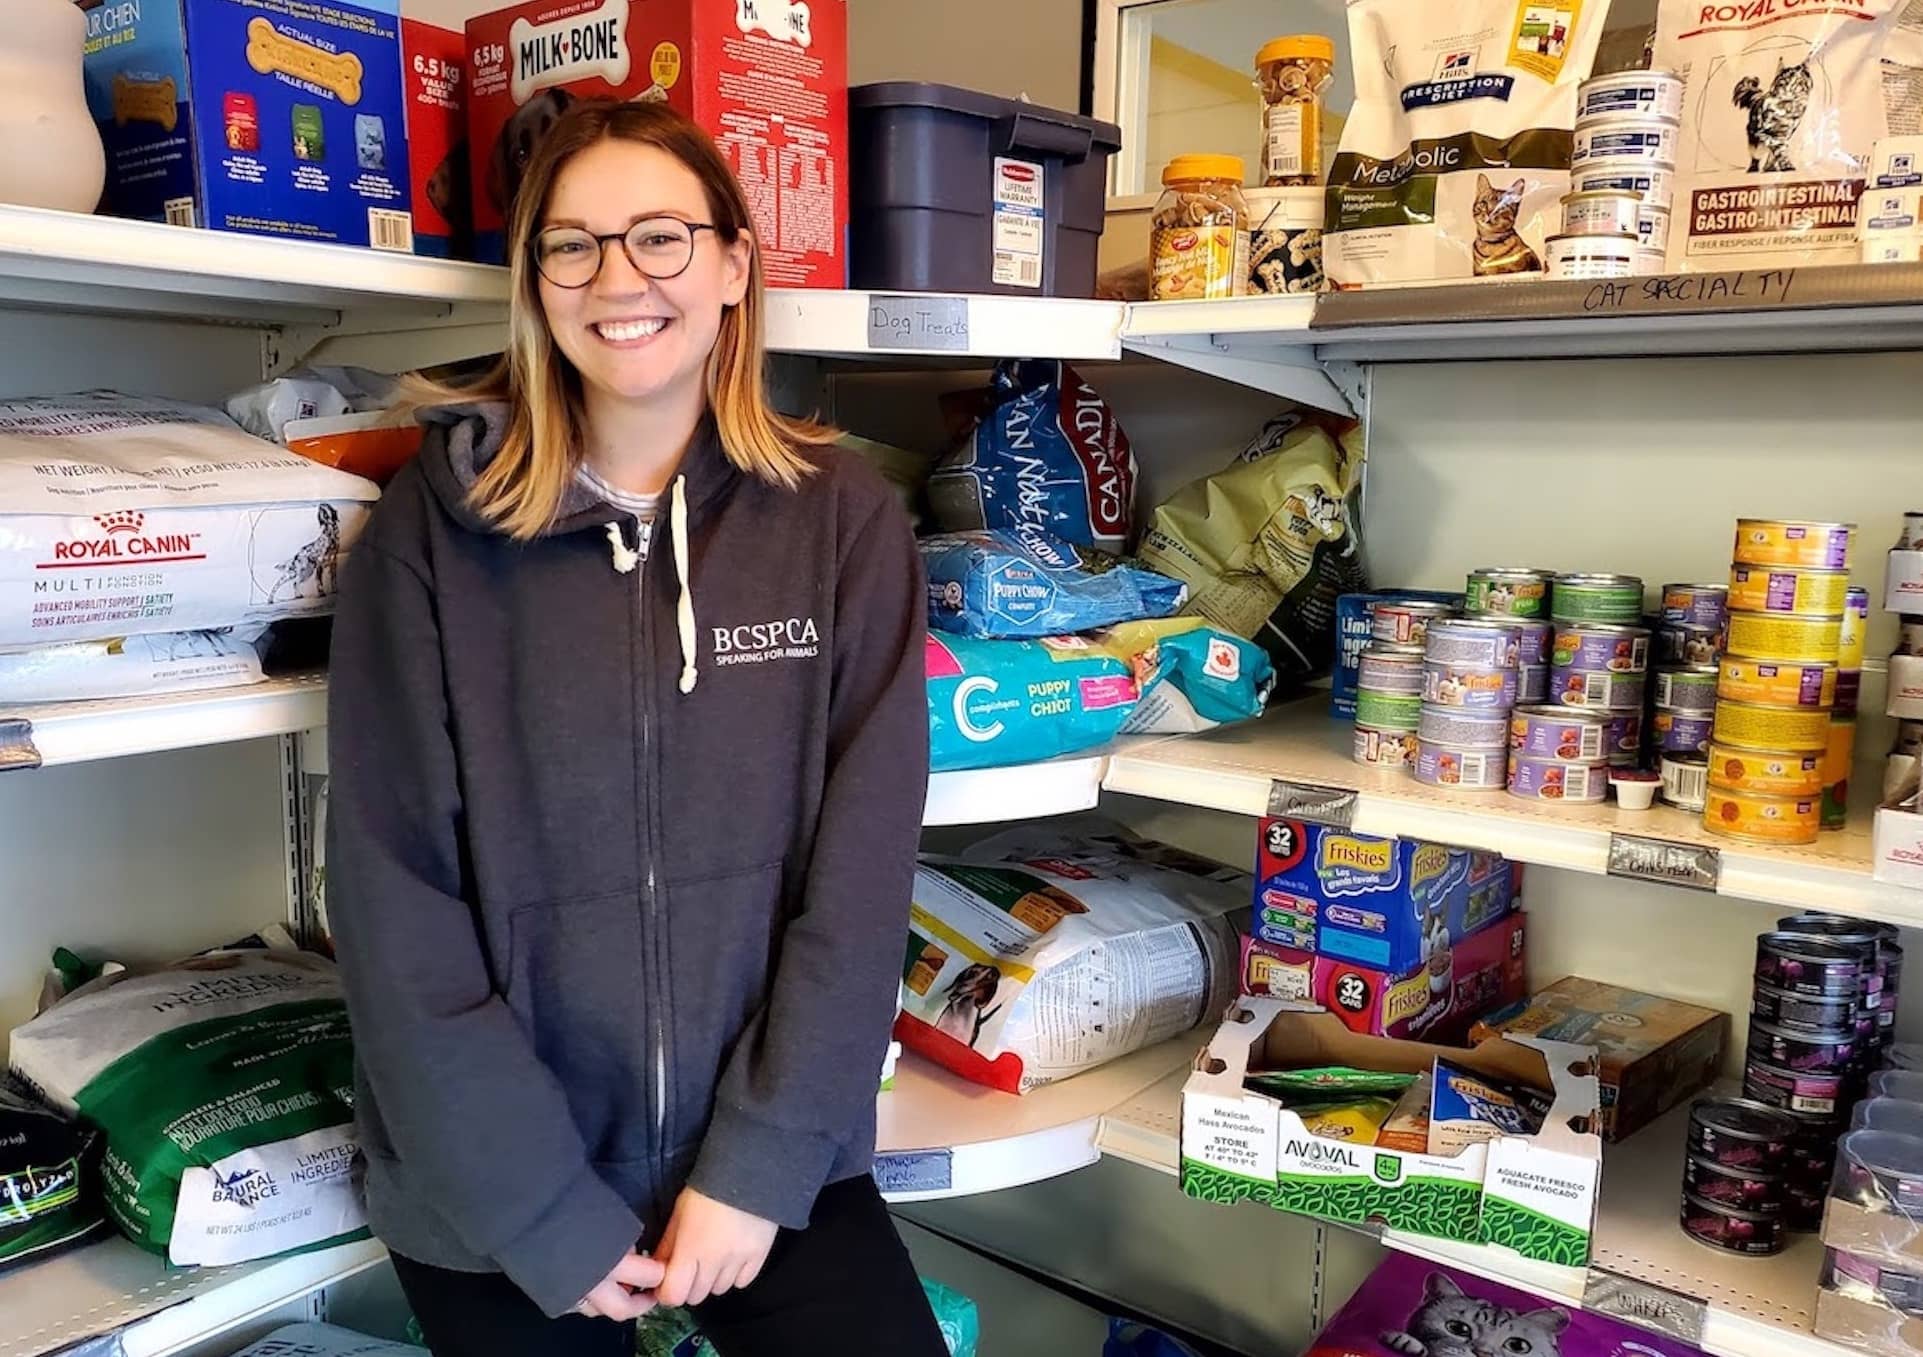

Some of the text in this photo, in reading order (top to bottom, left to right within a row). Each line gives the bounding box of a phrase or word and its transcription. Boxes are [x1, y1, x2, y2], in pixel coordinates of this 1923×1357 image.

[103, 0, 141, 31] CHIEN
[1700, 0, 1775, 24] ROYAL
[277, 24, 336, 53] ACTUAL SIZE
[521, 31, 564, 81] MILK
[571, 18, 618, 63] BONE
[490, 44, 505, 63] kg
[275, 71, 302, 89] TAILLE
[413, 54, 439, 77] 6.5
[440, 60, 460, 84] kg
[420, 76, 455, 91] VALUE
[1402, 78, 1505, 102] PRESCRIPTION
[1431, 90, 1465, 102] DIET
[999, 191, 1037, 203] WARRANTY
[1004, 183, 1032, 195] LIFETIME
[1343, 194, 1376, 203] Weight
[1697, 185, 1857, 211] GASTROINTESTINAL
[1341, 200, 1398, 214] Management
[1695, 205, 1858, 232] GASTRO-INTESTINAL
[1693, 238, 1717, 250] FIBER
[1719, 237, 1764, 248] RESPONSE
[1584, 282, 1633, 311] CAT
[872, 306, 968, 338] Dog Treats
[1075, 384, 1121, 523] CANADI
[33, 465, 58, 477] NET
[60, 464, 108, 478] WEIGHT
[183, 463, 214, 476] PESO
[55, 534, 191, 559] ROYAL CANIN
[34, 573, 163, 593] MULTI FUNCTION
[107, 579, 163, 589] FONCTION
[993, 582, 1050, 598] PUPPY CHOW
[32, 592, 174, 614] ADVANCED MOBILITY SUPPORT SATIETY
[32, 616, 55, 628] SOINS
[56, 611, 105, 626] ARTICULAIRES
[106, 608, 140, 621] ENRICHIS
[1341, 617, 1373, 635] Limi
[716, 645, 819, 666] SPEAKING FOR ANIMALS
[1342, 652, 1360, 670] Die
[1028, 679, 1072, 698] PUPPY
[969, 698, 1020, 715] compliments
[1031, 697, 1072, 717] CHIOT
[1269, 825, 1293, 847] 32
[1329, 842, 1387, 867] Friskies
[1414, 848, 1448, 880] Friskies
[1341, 977, 1365, 1001] 32
[1390, 986, 1428, 1016] Friskies
[225, 1078, 281, 1102] BALANCED
[168, 1094, 263, 1145] ADULT DOG FOOD
[1214, 1108, 1250, 1120] Mexican
[178, 1112, 250, 1153] NOURRITURE
[249, 1101, 281, 1125] POUR
[1198, 1117, 1265, 1134] Hass Avocados
[1213, 1136, 1249, 1149] STORE
[1230, 1149, 1244, 1157] TO
[1284, 1139, 1361, 1168] AVOVAL
[297, 1143, 356, 1168] LIMITED
[1227, 1156, 1239, 1164] TO
[291, 1157, 352, 1184] INGREDIE
[1300, 1160, 1343, 1174] avocados
[1497, 1168, 1586, 1192] AGUACATE FRESCO
[1502, 1177, 1579, 1200] FRESH AVOCADO
[212, 1184, 281, 1208] BAANCE
